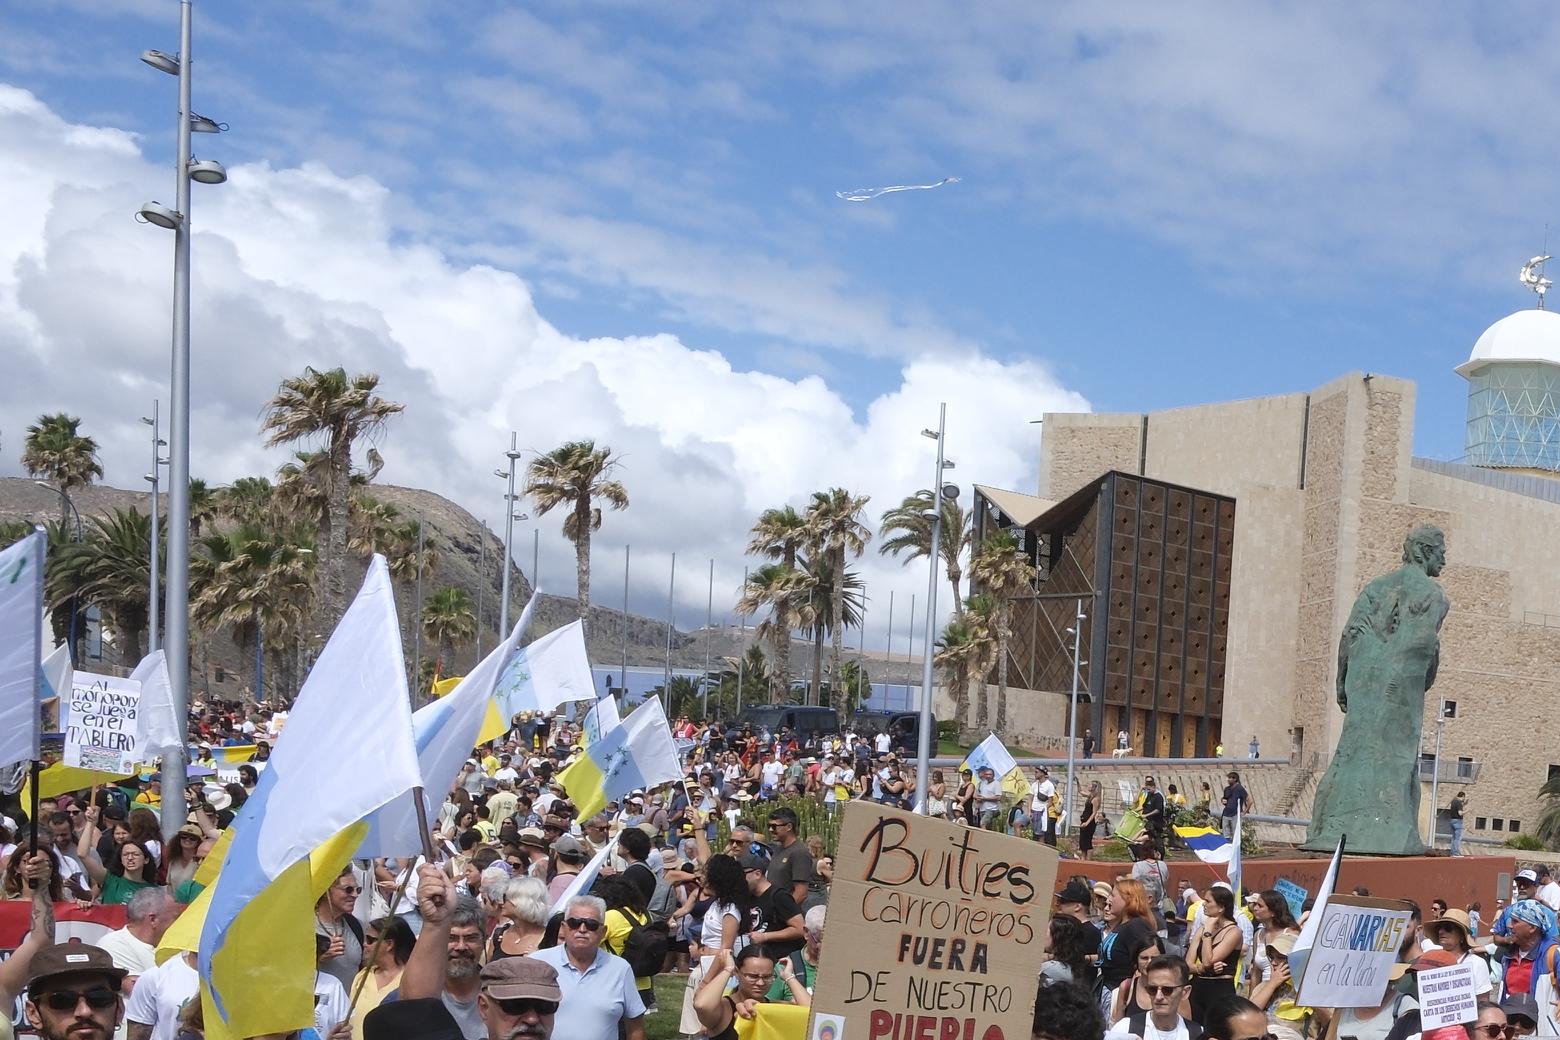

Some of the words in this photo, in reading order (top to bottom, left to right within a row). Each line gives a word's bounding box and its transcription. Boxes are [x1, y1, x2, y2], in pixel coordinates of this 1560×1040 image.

[72, 701, 92, 713] se
[83, 714, 104, 727] en
[68, 726, 135, 752] TABLERO
[860, 816, 1035, 905] Buitres
[1320, 912, 1406, 953] CANARIAS
[898, 934, 988, 975] FUERA
[845, 969, 891, 1004] DE
[907, 975, 1012, 1013] NUESTRO
